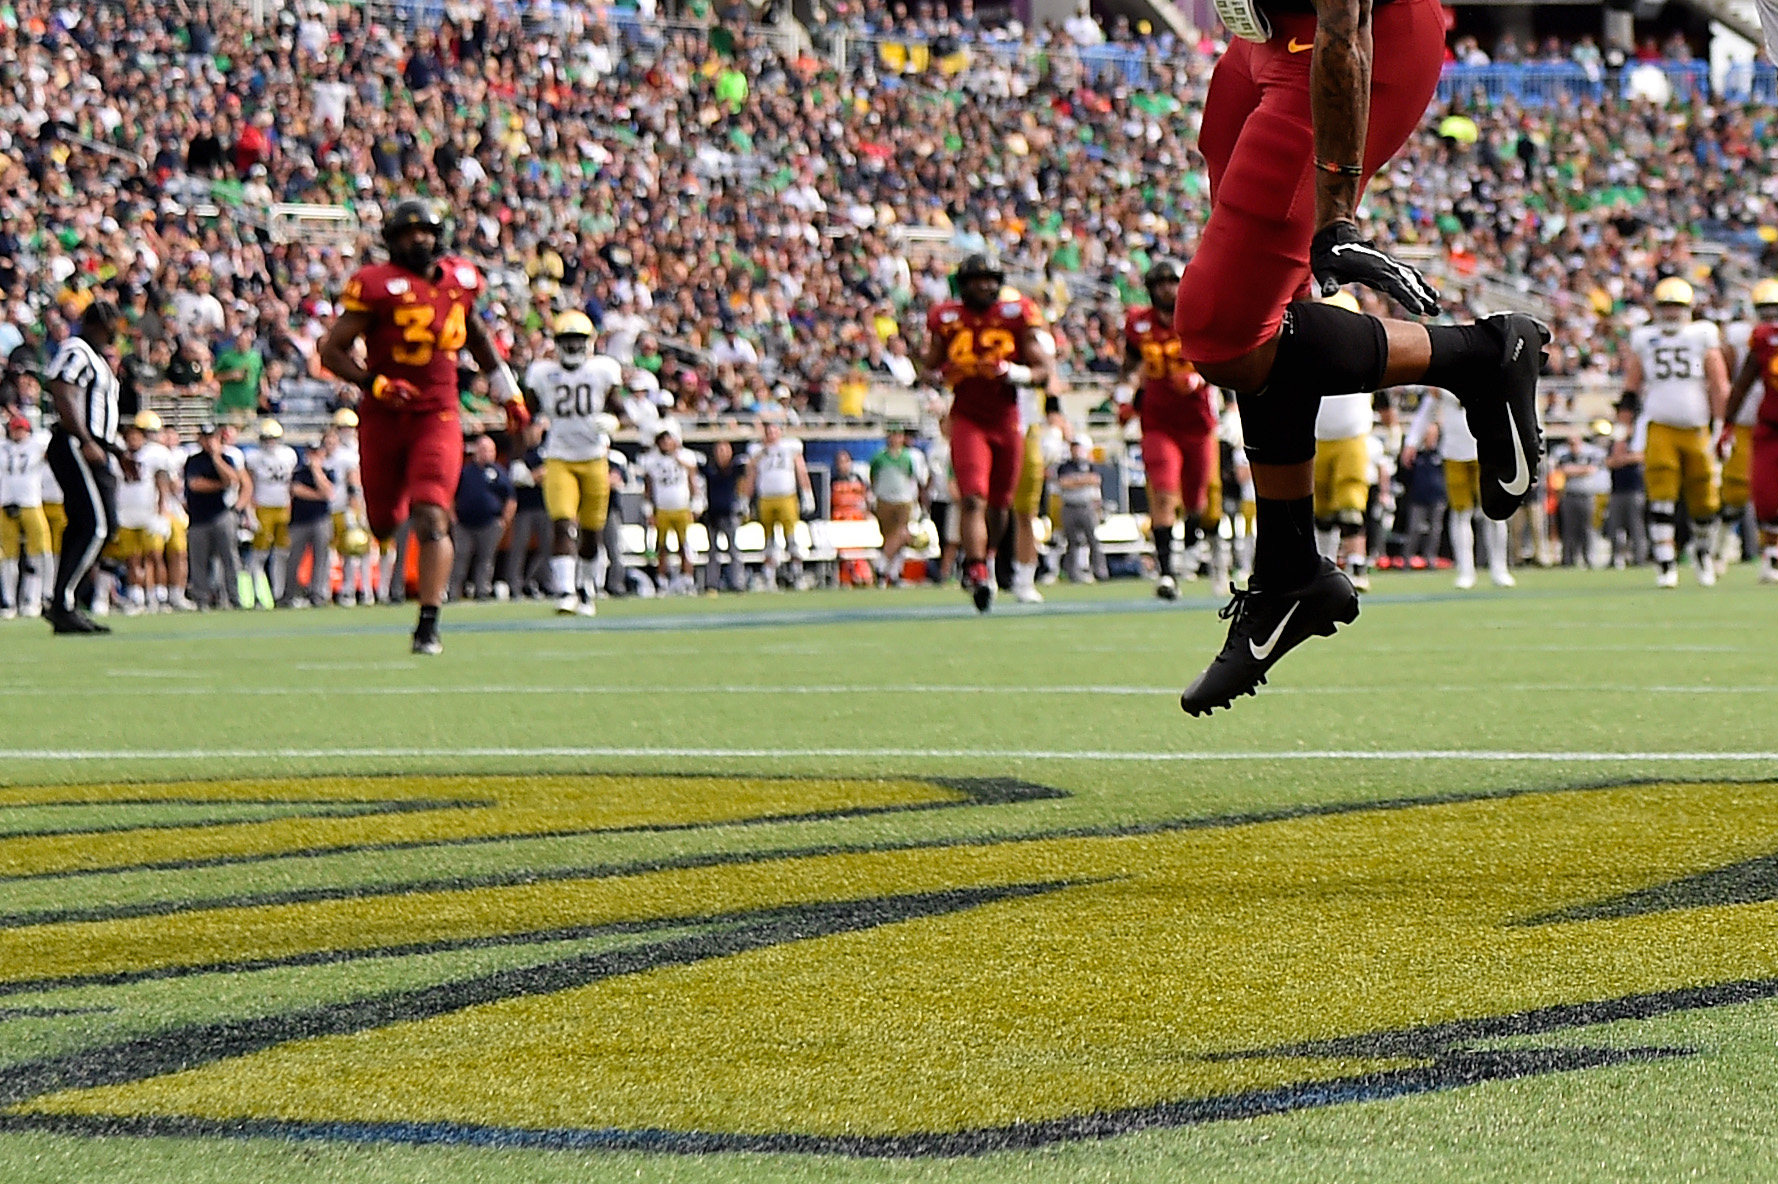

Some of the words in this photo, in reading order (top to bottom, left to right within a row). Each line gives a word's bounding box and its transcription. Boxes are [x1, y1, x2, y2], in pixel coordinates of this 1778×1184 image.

[392, 302, 467, 366] 34
[1654, 346, 1691, 380] 55
[554, 383, 593, 417] 20
